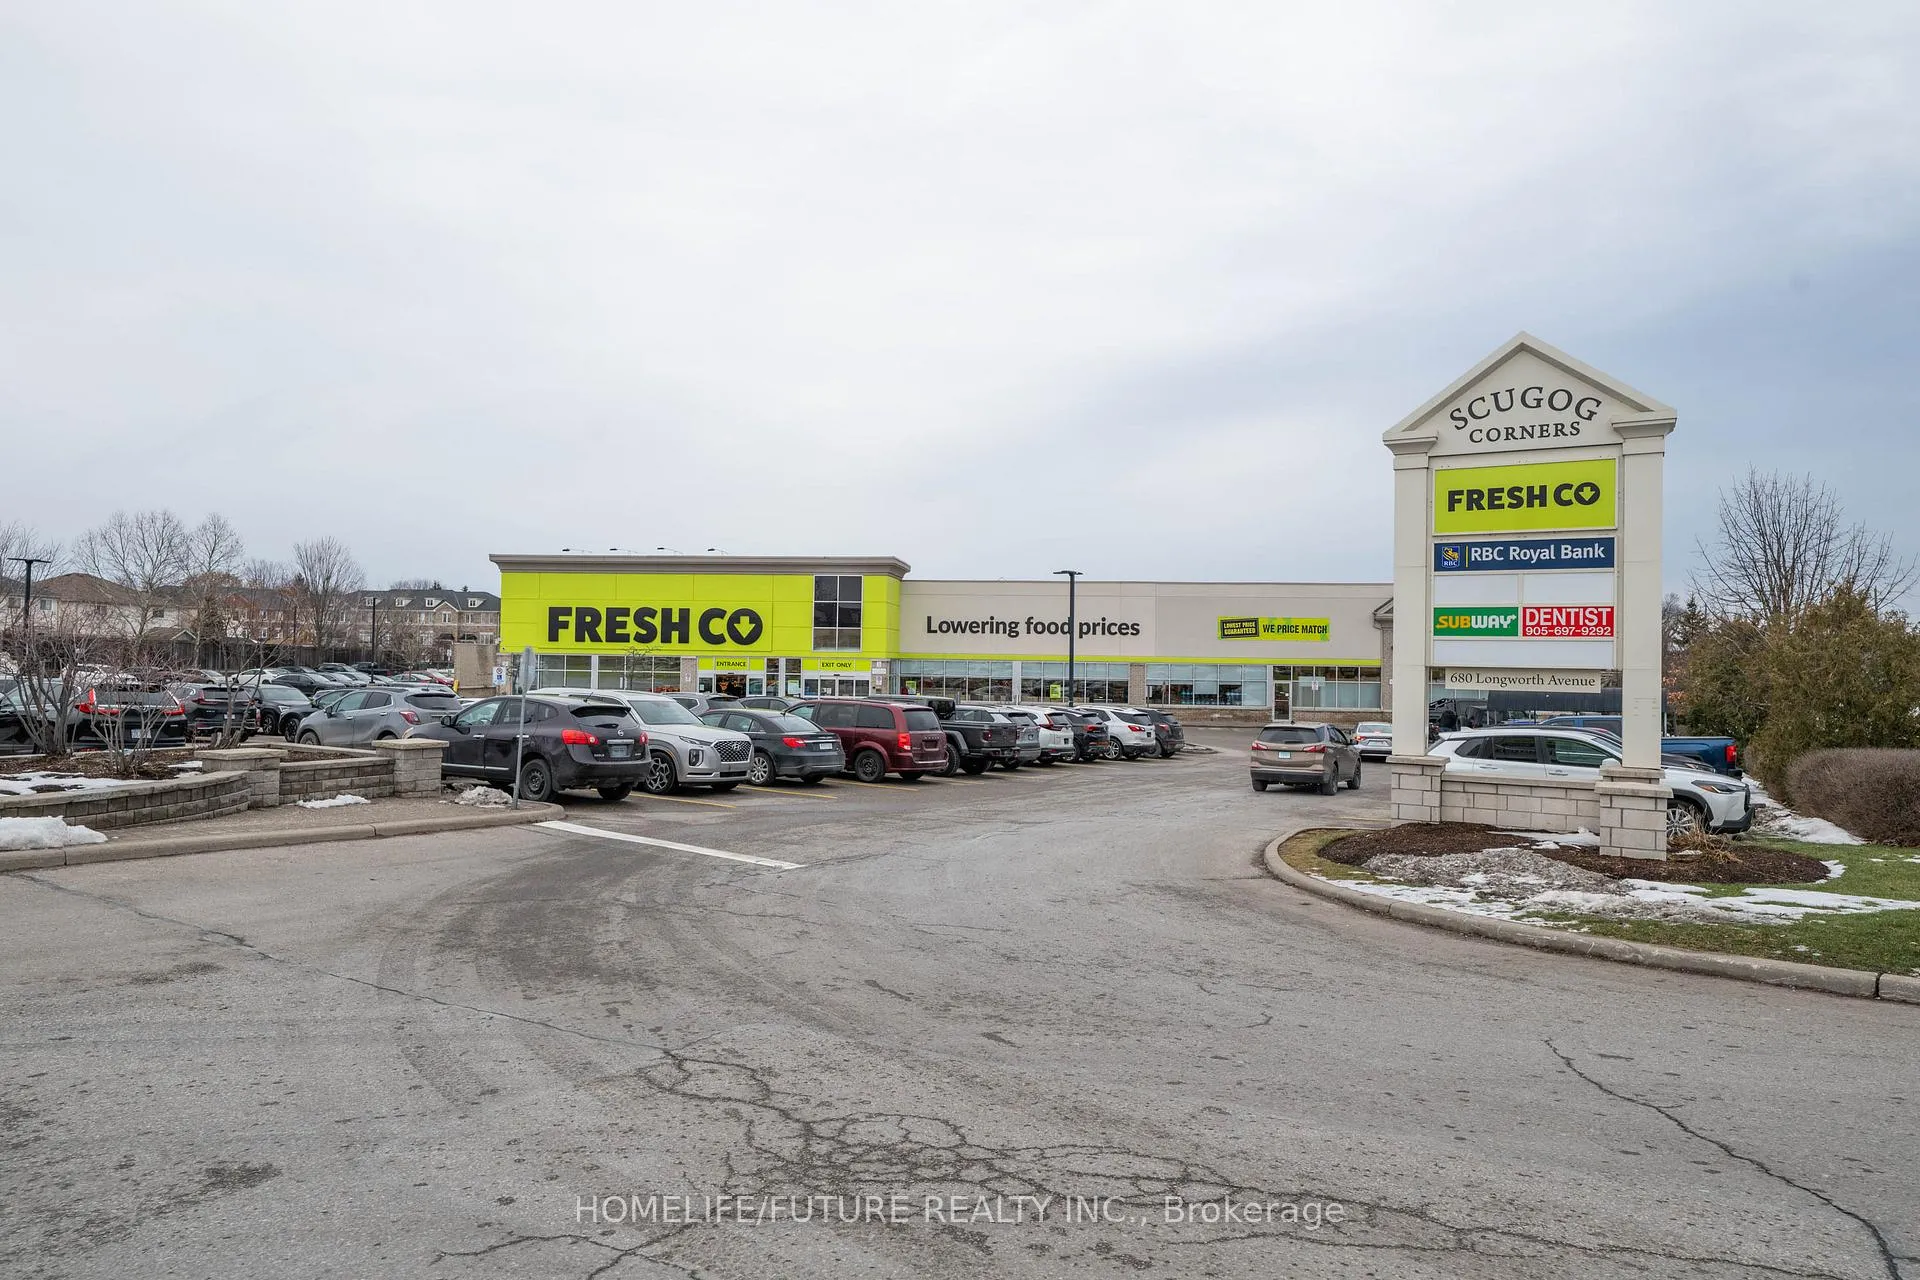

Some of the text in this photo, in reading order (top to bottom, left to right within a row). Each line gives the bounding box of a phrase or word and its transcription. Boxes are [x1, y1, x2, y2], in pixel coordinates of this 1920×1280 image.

[1450, 386, 1602, 430] SCUGOG
[1469, 421, 1581, 443] CORNERS
[1447, 482, 1601, 512] FRESH CO
[1471, 543, 1606, 563] RBC Royal Bank
[548, 606, 763, 646] FRESH CO
[1436, 614, 1517, 629] SUBWAY
[1525, 607, 1612, 626] DENTIST
[926, 615, 1141, 639] Lowering food prices
[1262, 624, 1328, 634] WE PRICE MATCH
[1525, 626, 1612, 636] 905-697-9292
[1450, 672, 1596, 688] 680 Longworth Avenue
